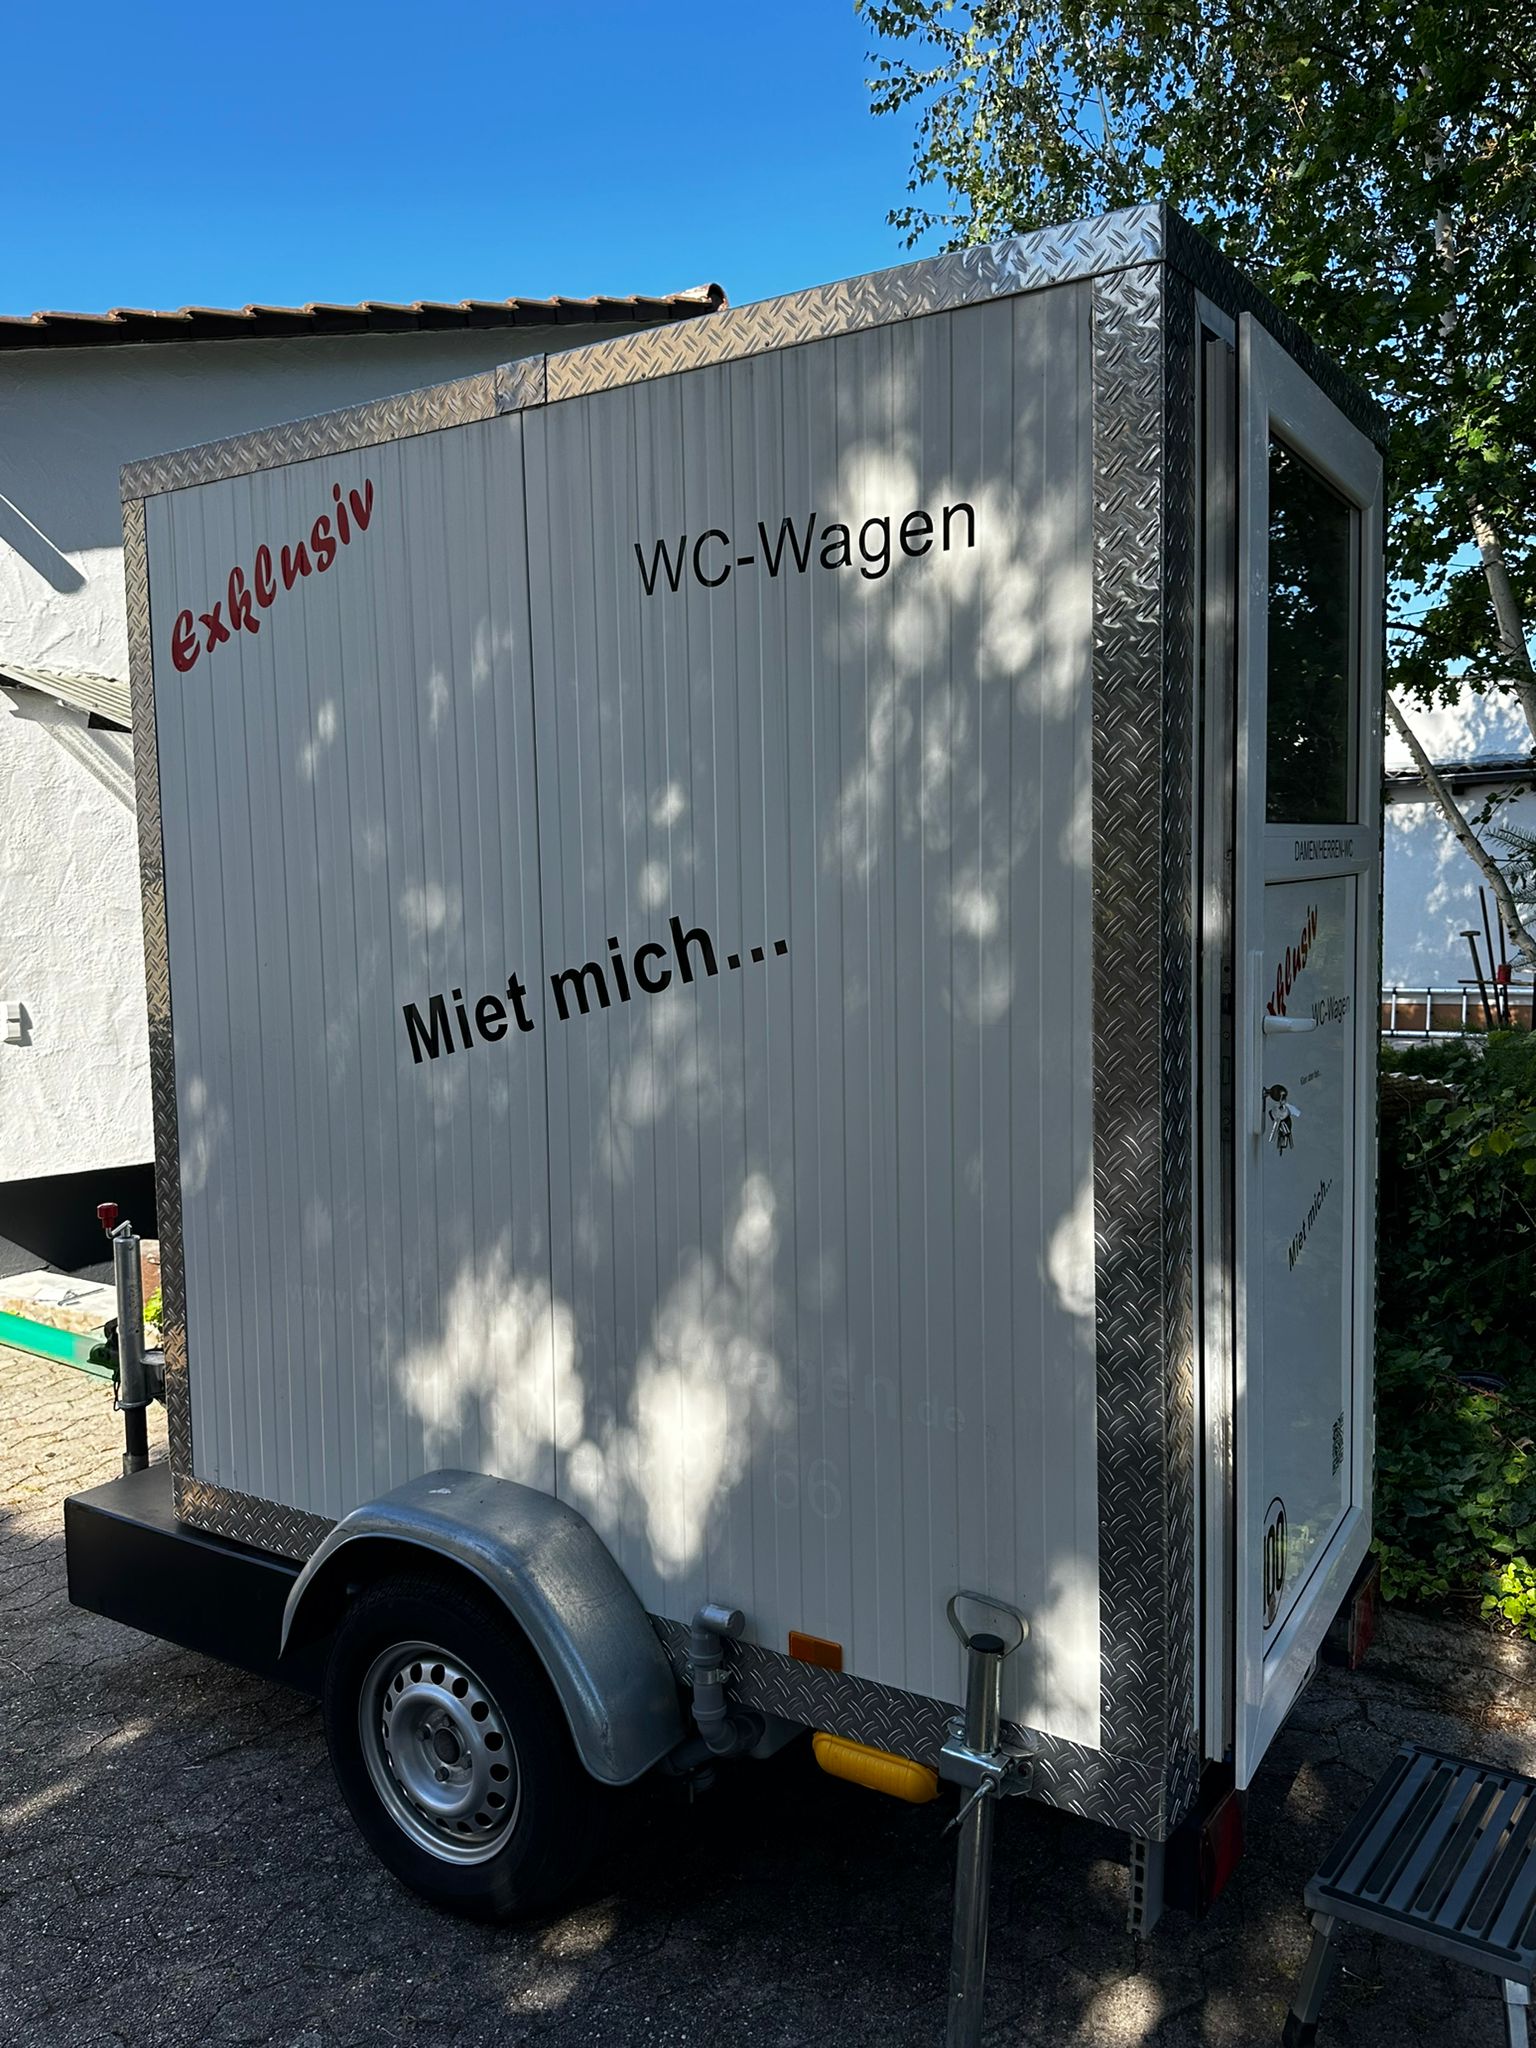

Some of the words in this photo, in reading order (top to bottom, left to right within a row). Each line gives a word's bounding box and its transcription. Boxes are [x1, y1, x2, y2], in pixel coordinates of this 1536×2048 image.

[171, 478, 374, 673] Exklusiv
[634, 502, 975, 596] WC-Wagen
[402, 972, 535, 1064] Miet
[550, 915, 788, 1021] mich...
[1311, 995, 1351, 1027] WC-Wagen
[1288, 1219, 1307, 1272] Miet
